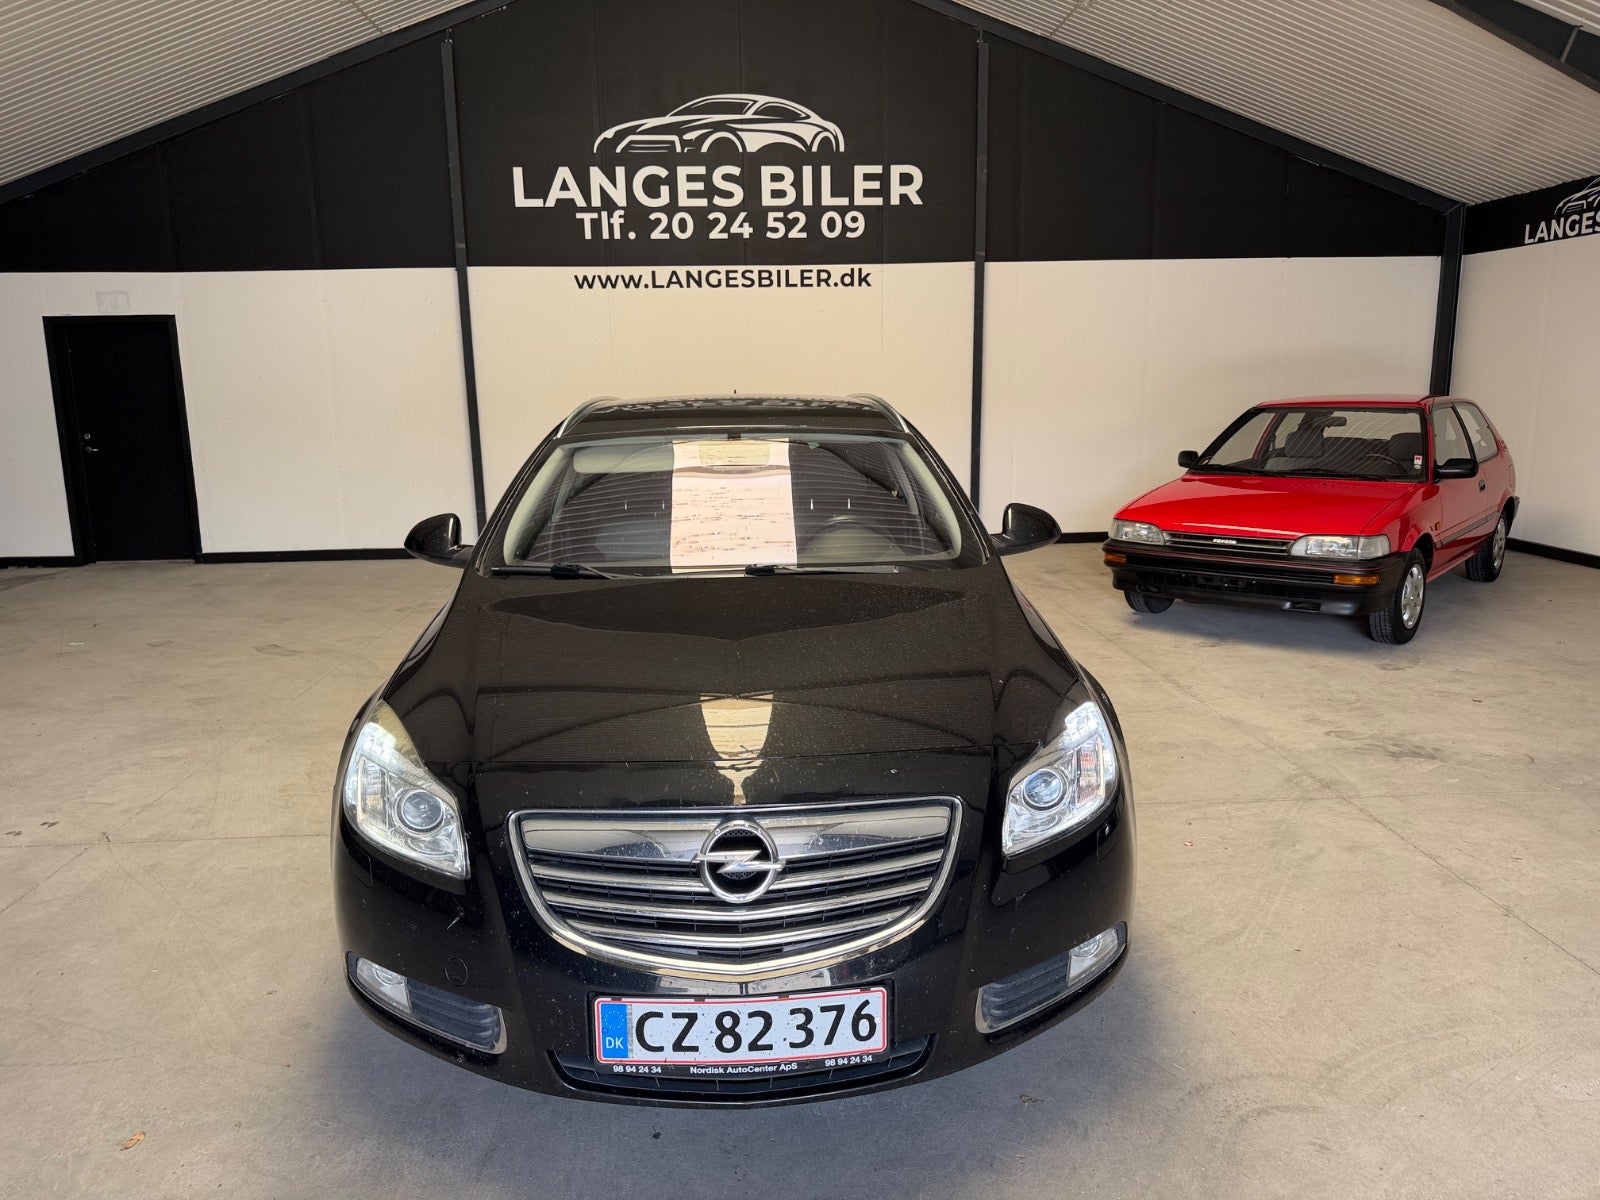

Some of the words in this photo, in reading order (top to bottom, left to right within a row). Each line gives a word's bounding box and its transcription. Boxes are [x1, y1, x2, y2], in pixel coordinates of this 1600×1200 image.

[512, 165, 744, 208] LANGES
[760, 164, 924, 207] BILER
[576, 210, 637, 240] Tlf.
[648, 211, 694, 240] 20
[707, 211, 754, 240] 24
[765, 210, 808, 240] 52
[820, 210, 866, 239] 09
[574, 267, 872, 290] www.LANGESBILER.dk
[634, 1010, 700, 1053] CZ
[714, 1009, 774, 1053] 82
[788, 999, 877, 1049] 376
[605, 1036, 624, 1049] DK
[612, 1064, 624, 1073] 98
[625, 1065, 637, 1073] 94
[638, 1065, 650, 1074] 24
[650, 1065, 662, 1074] 34
[689, 1065, 725, 1074] Nordisk
[726, 1064, 777, 1074] AutoCenter
[779, 1062, 798, 1073] ApS
[825, 1059, 836, 1067] 98
[838, 1058, 848, 1066] 94
[850, 1056, 861, 1064] 24
[862, 1054, 873, 1063] 34
